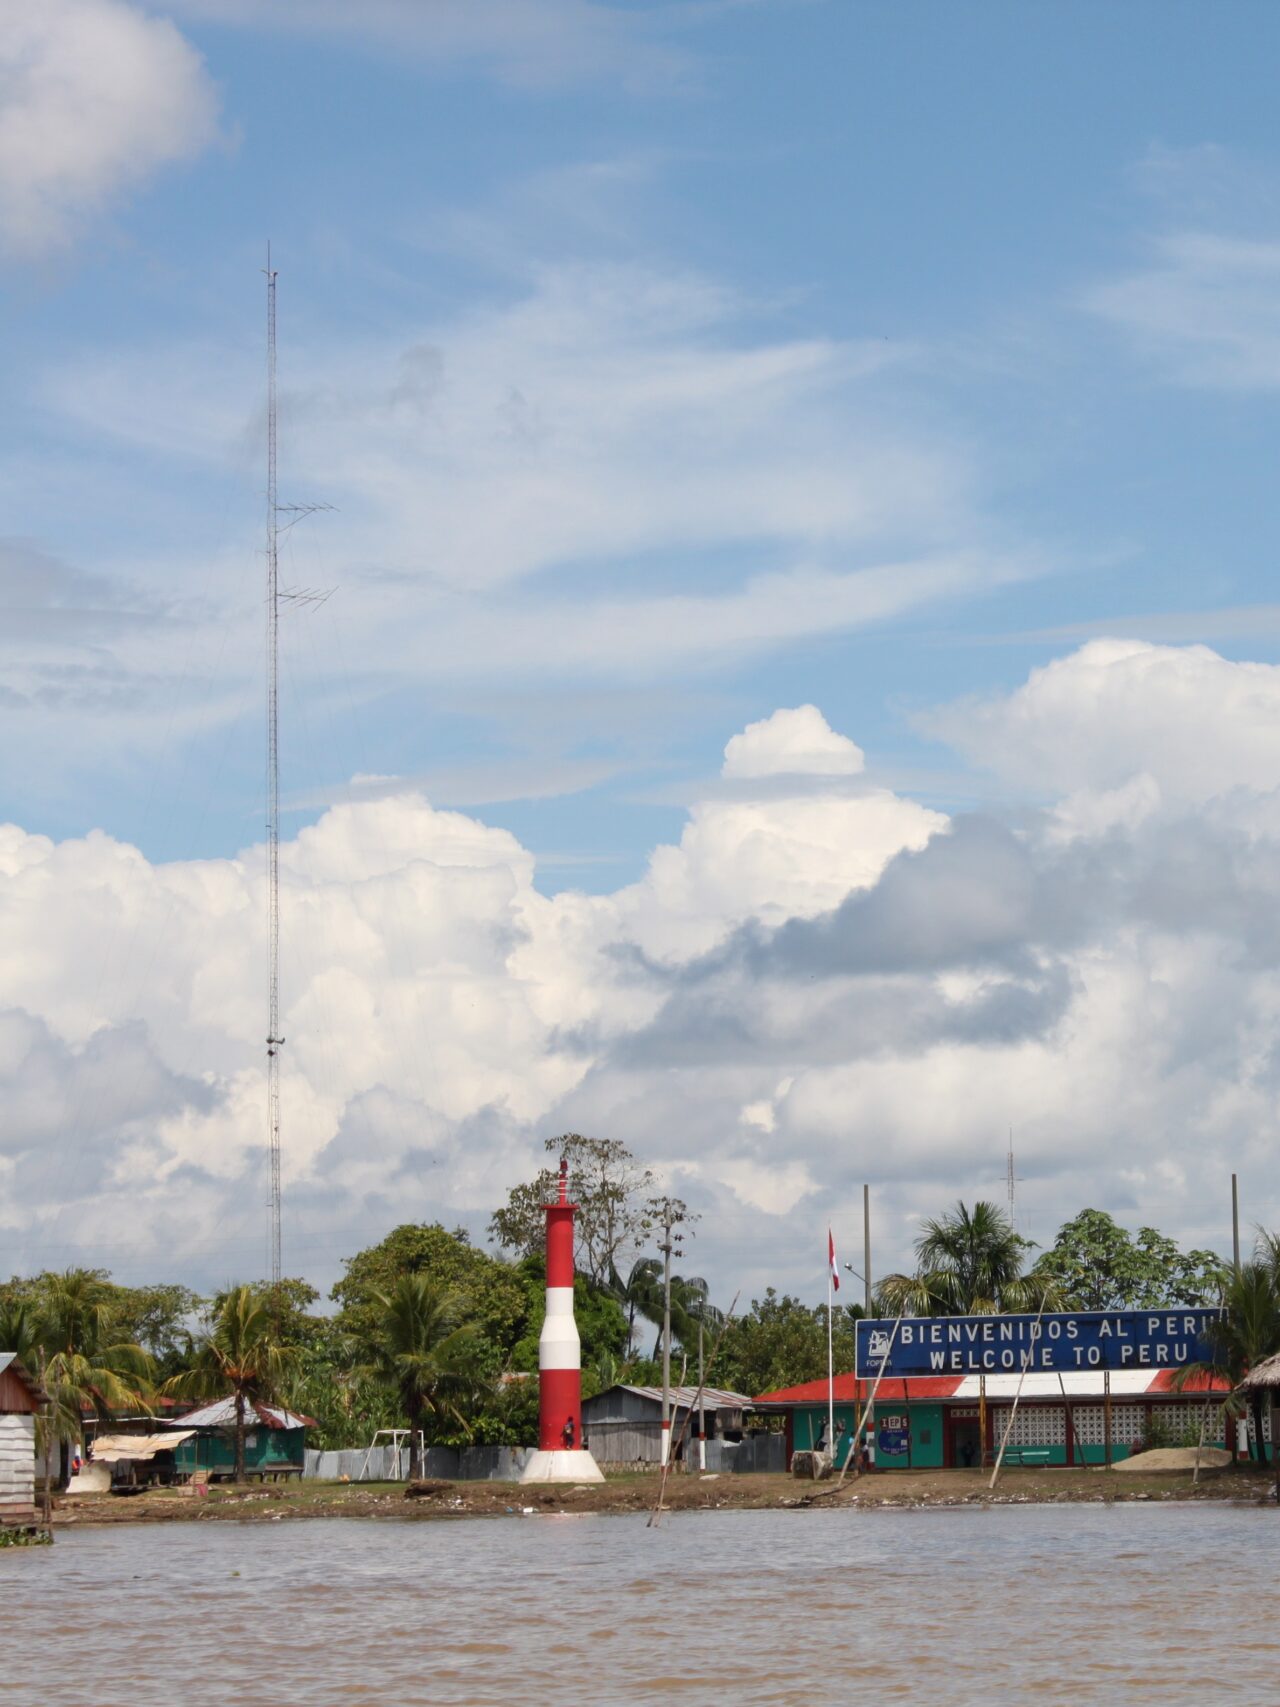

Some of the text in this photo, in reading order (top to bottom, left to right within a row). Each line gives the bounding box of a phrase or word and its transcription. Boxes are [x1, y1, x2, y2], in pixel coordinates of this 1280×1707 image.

[901, 1320, 1079, 1345] BIENVENIDOS
[1099, 1319, 1129, 1338] AL
[930, 1343, 1187, 1370] WELCOME TO PERU
